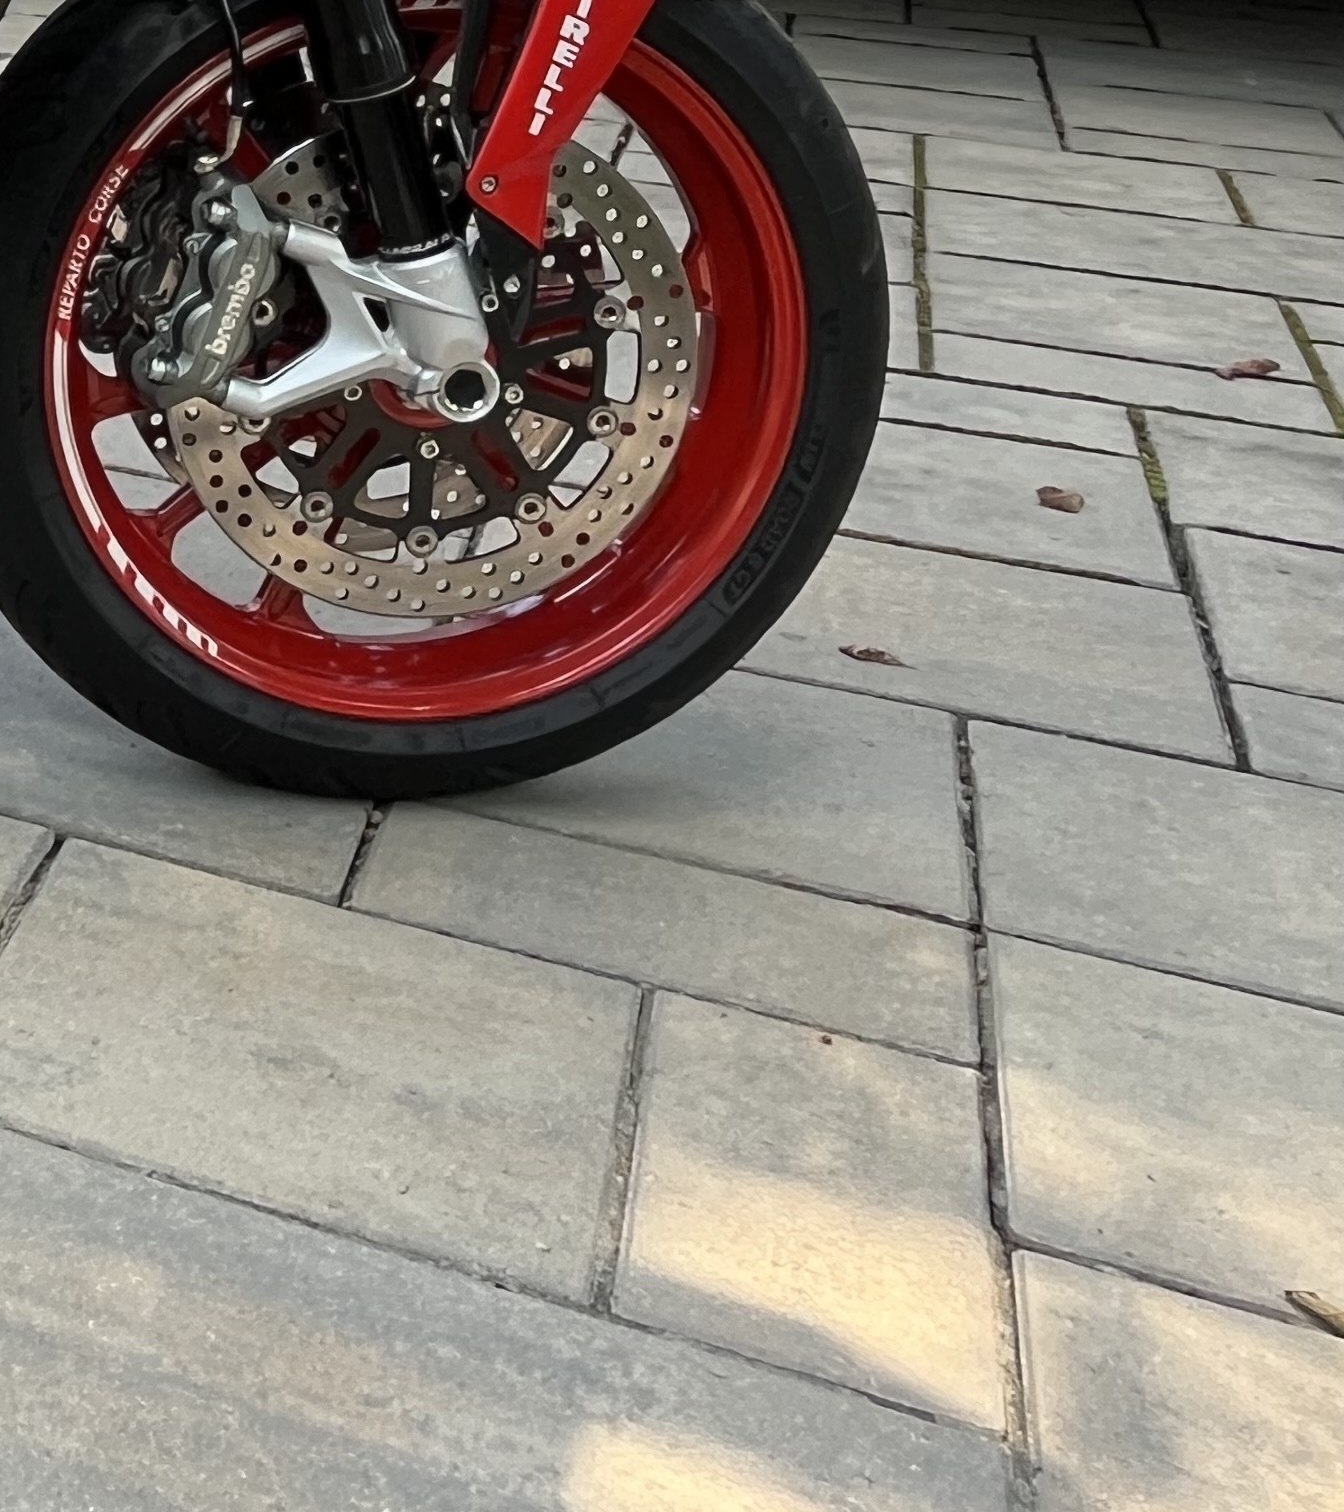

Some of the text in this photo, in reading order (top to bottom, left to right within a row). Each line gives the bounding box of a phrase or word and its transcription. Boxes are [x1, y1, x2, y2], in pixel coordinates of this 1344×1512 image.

[57, 163, 130, 322] REPARTO CORSE
[204, 262, 257, 356] brembo
